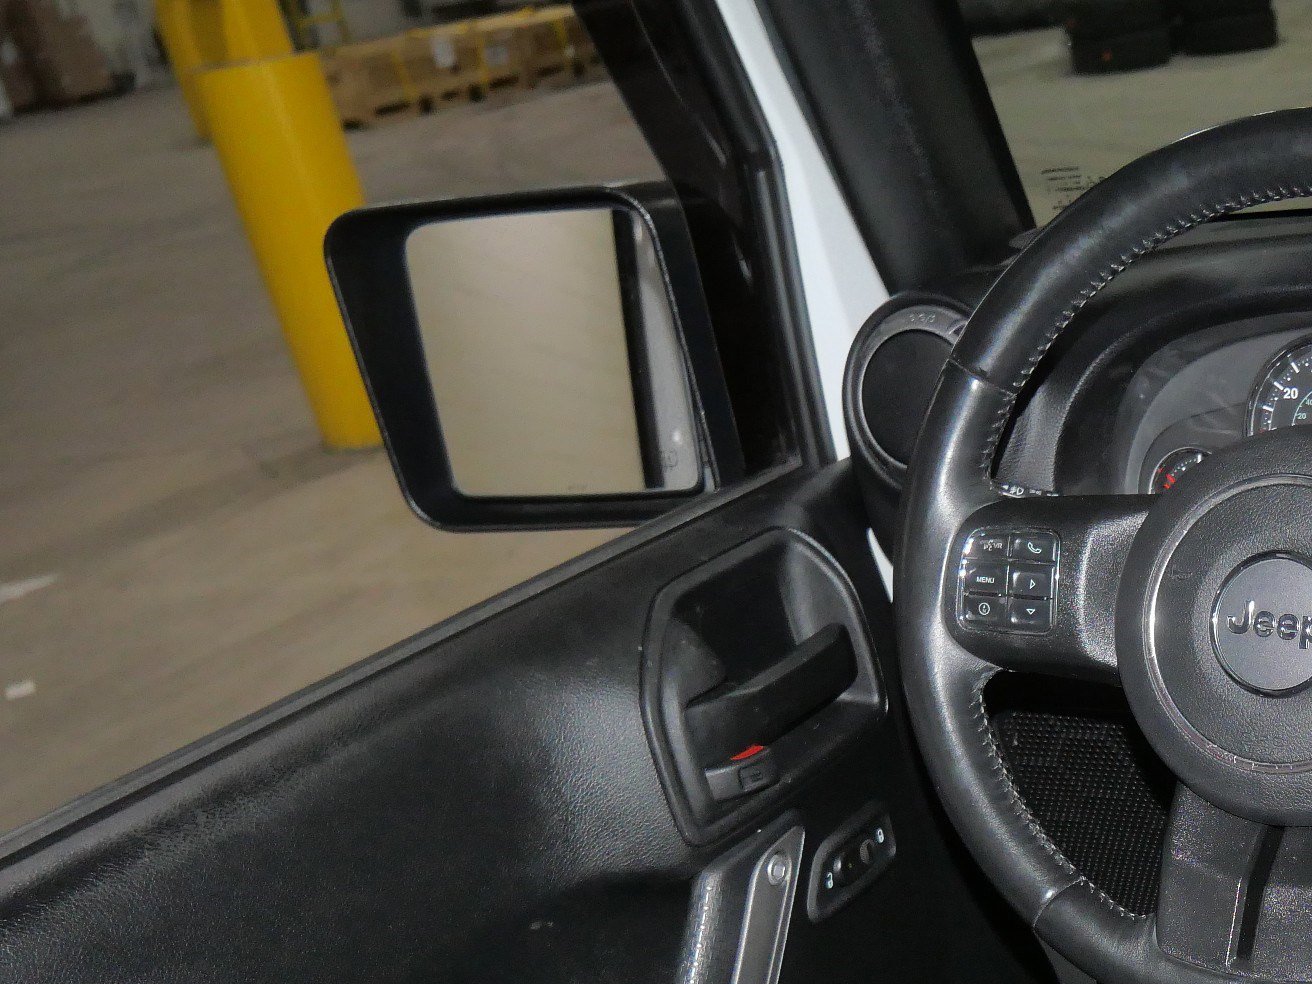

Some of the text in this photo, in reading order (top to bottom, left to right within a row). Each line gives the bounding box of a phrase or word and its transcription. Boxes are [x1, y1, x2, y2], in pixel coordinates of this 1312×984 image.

[1283, 388, 1298, 399] 20
[1298, 412, 1307, 420] 20
[976, 576, 995, 584] MENU
